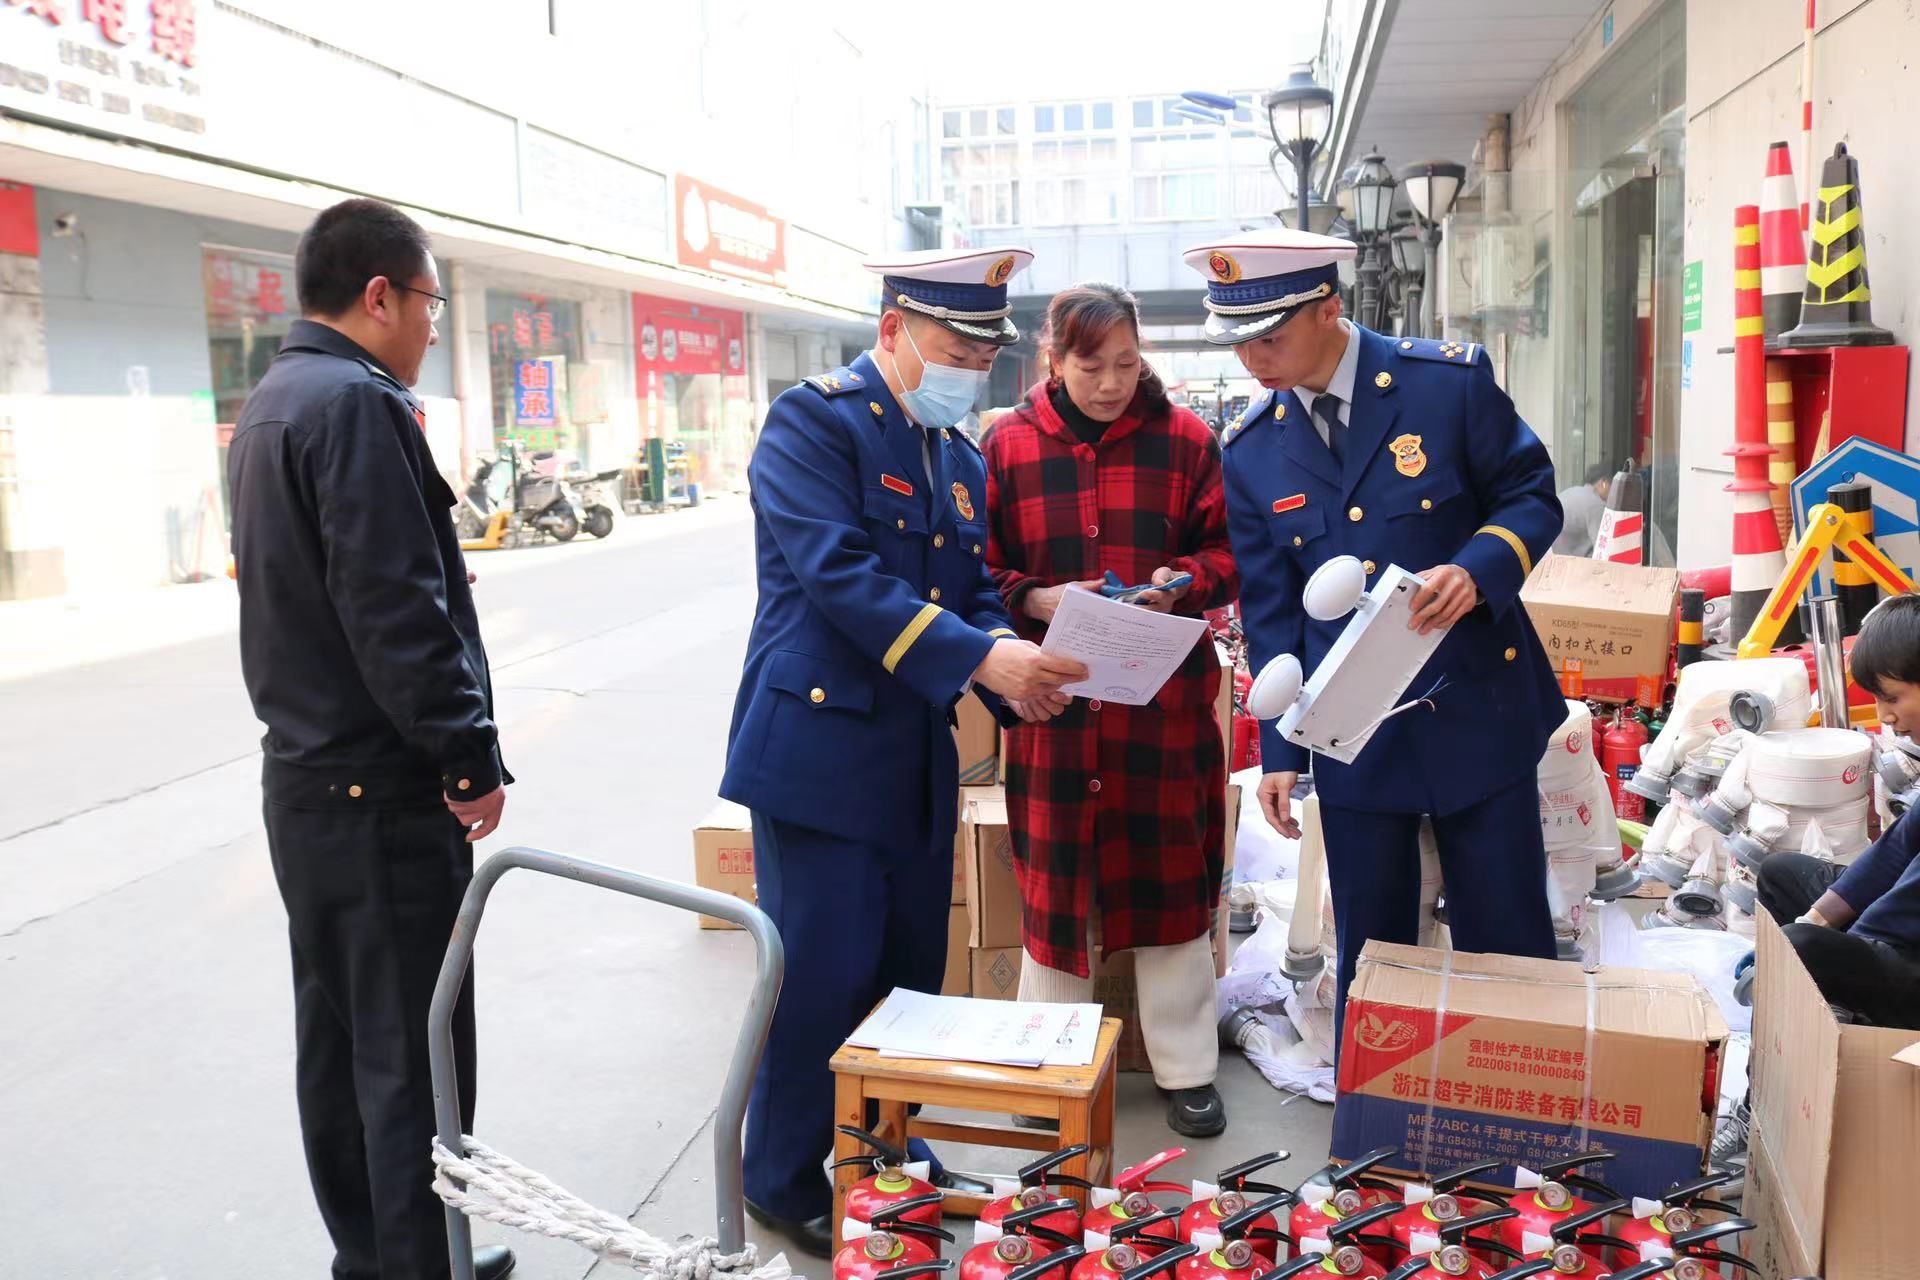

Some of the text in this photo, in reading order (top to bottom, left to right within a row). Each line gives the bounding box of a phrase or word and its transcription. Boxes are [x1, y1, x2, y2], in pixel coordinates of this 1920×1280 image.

[519, 360, 550, 418] 轴承
[1548, 633, 1634, 657] 内扣式接口
[1392, 1071, 1643, 1129] 浙江超宇消防装备有限公司
